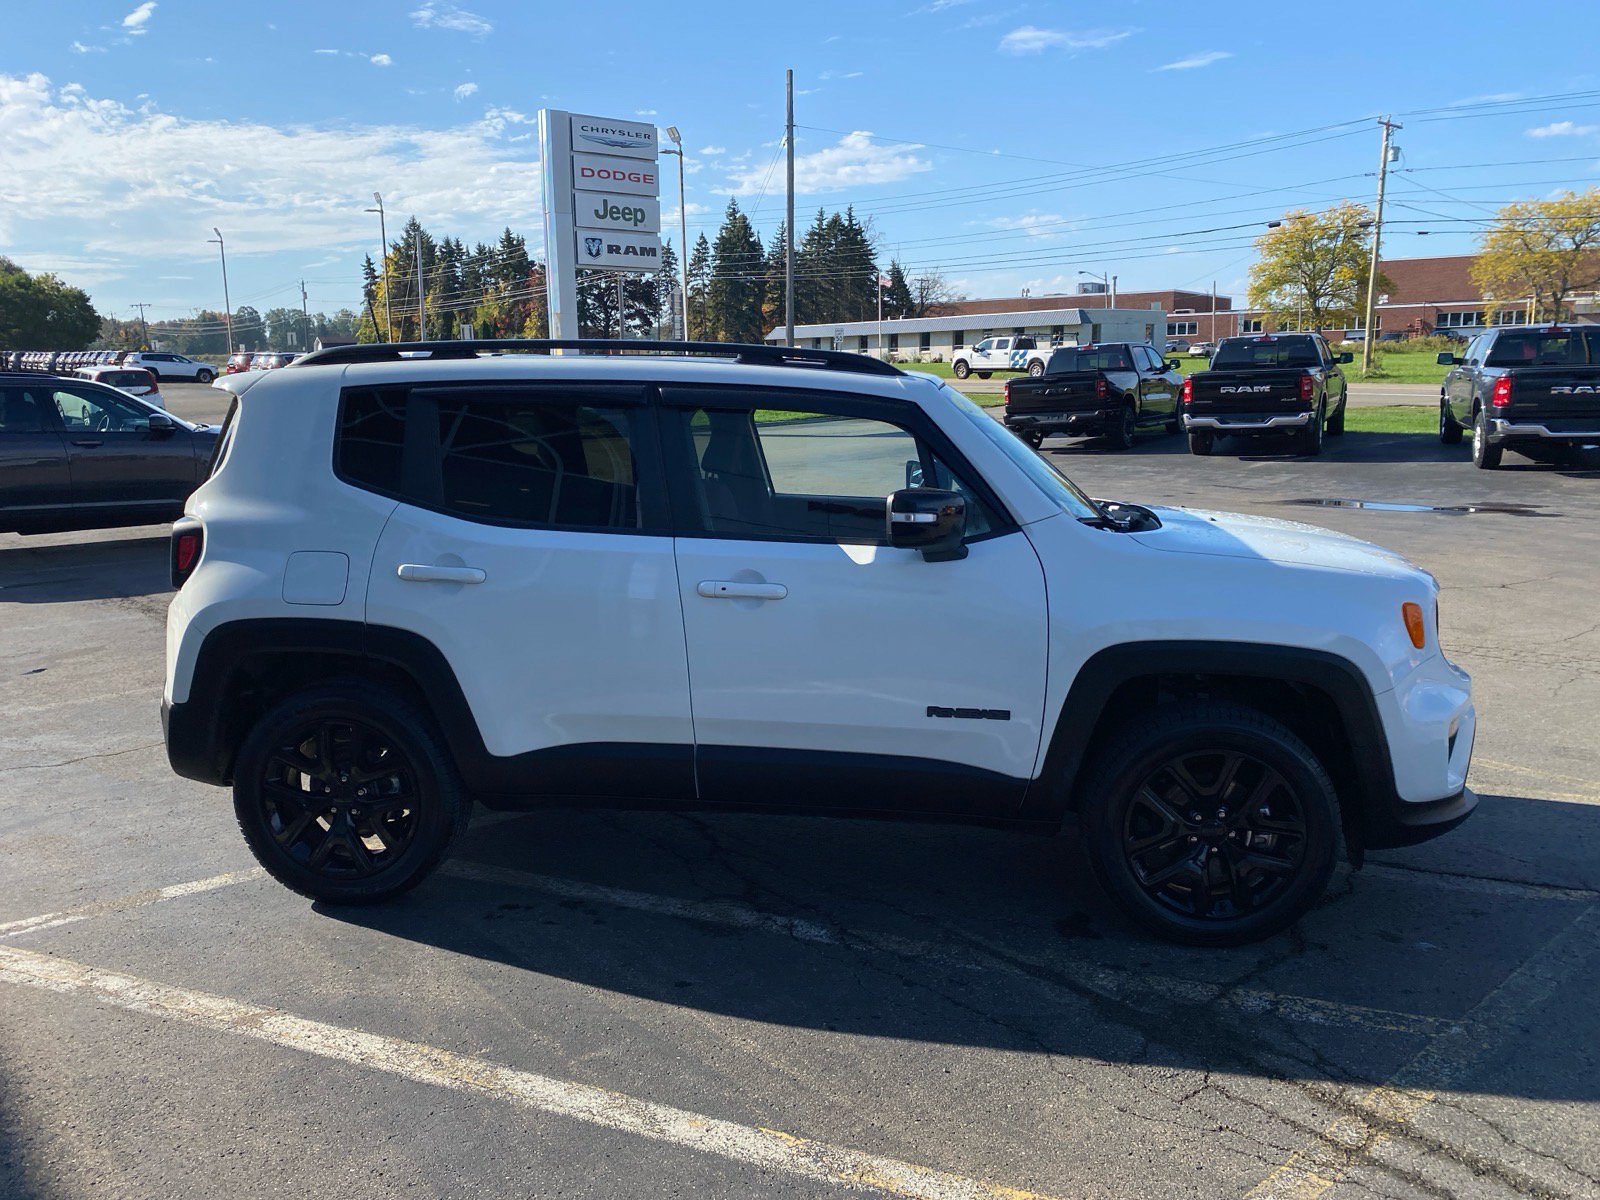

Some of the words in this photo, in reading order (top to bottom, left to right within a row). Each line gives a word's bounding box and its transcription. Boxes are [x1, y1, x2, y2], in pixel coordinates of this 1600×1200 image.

[581, 125, 651, 140] CHRYSLER
[581, 167, 654, 185] DODGE
[594, 198, 646, 227] Jeep
[606, 244, 657, 257] RAM
[1220, 384, 1271, 394] RAM
[1550, 386, 1600, 395] RA
